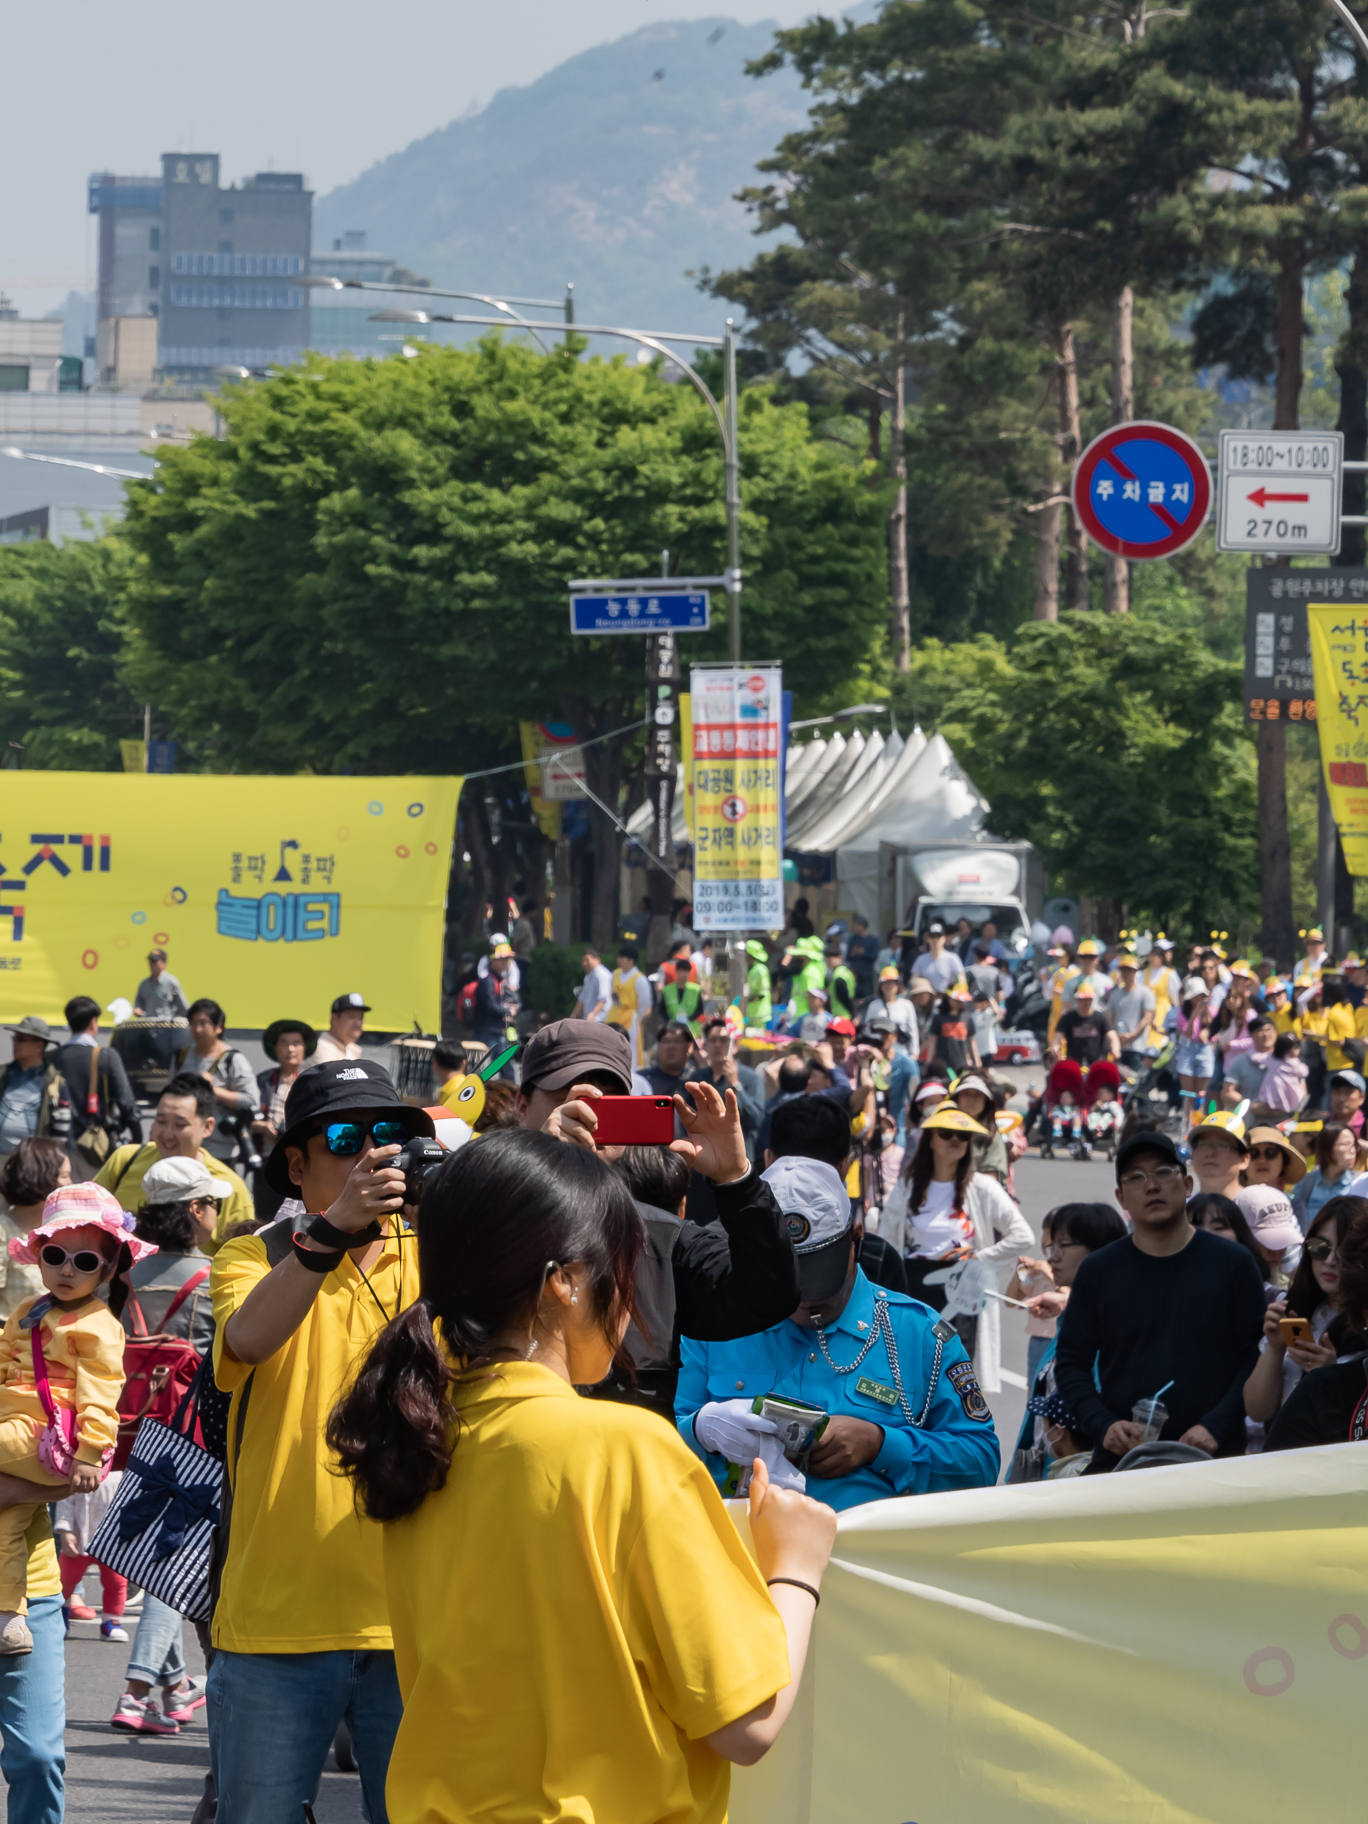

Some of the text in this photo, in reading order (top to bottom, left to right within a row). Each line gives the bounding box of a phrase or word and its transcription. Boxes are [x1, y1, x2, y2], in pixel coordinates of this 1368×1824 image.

[1232, 444, 1330, 469] 18:00~10:00
[1246, 519, 1308, 539] 270m
[604, 597, 663, 617] 능동로
[697, 767, 776, 793] 대공원 사거리
[698, 826, 776, 851] 군자역 사거리
[215, 888, 341, 942] 놀이터
